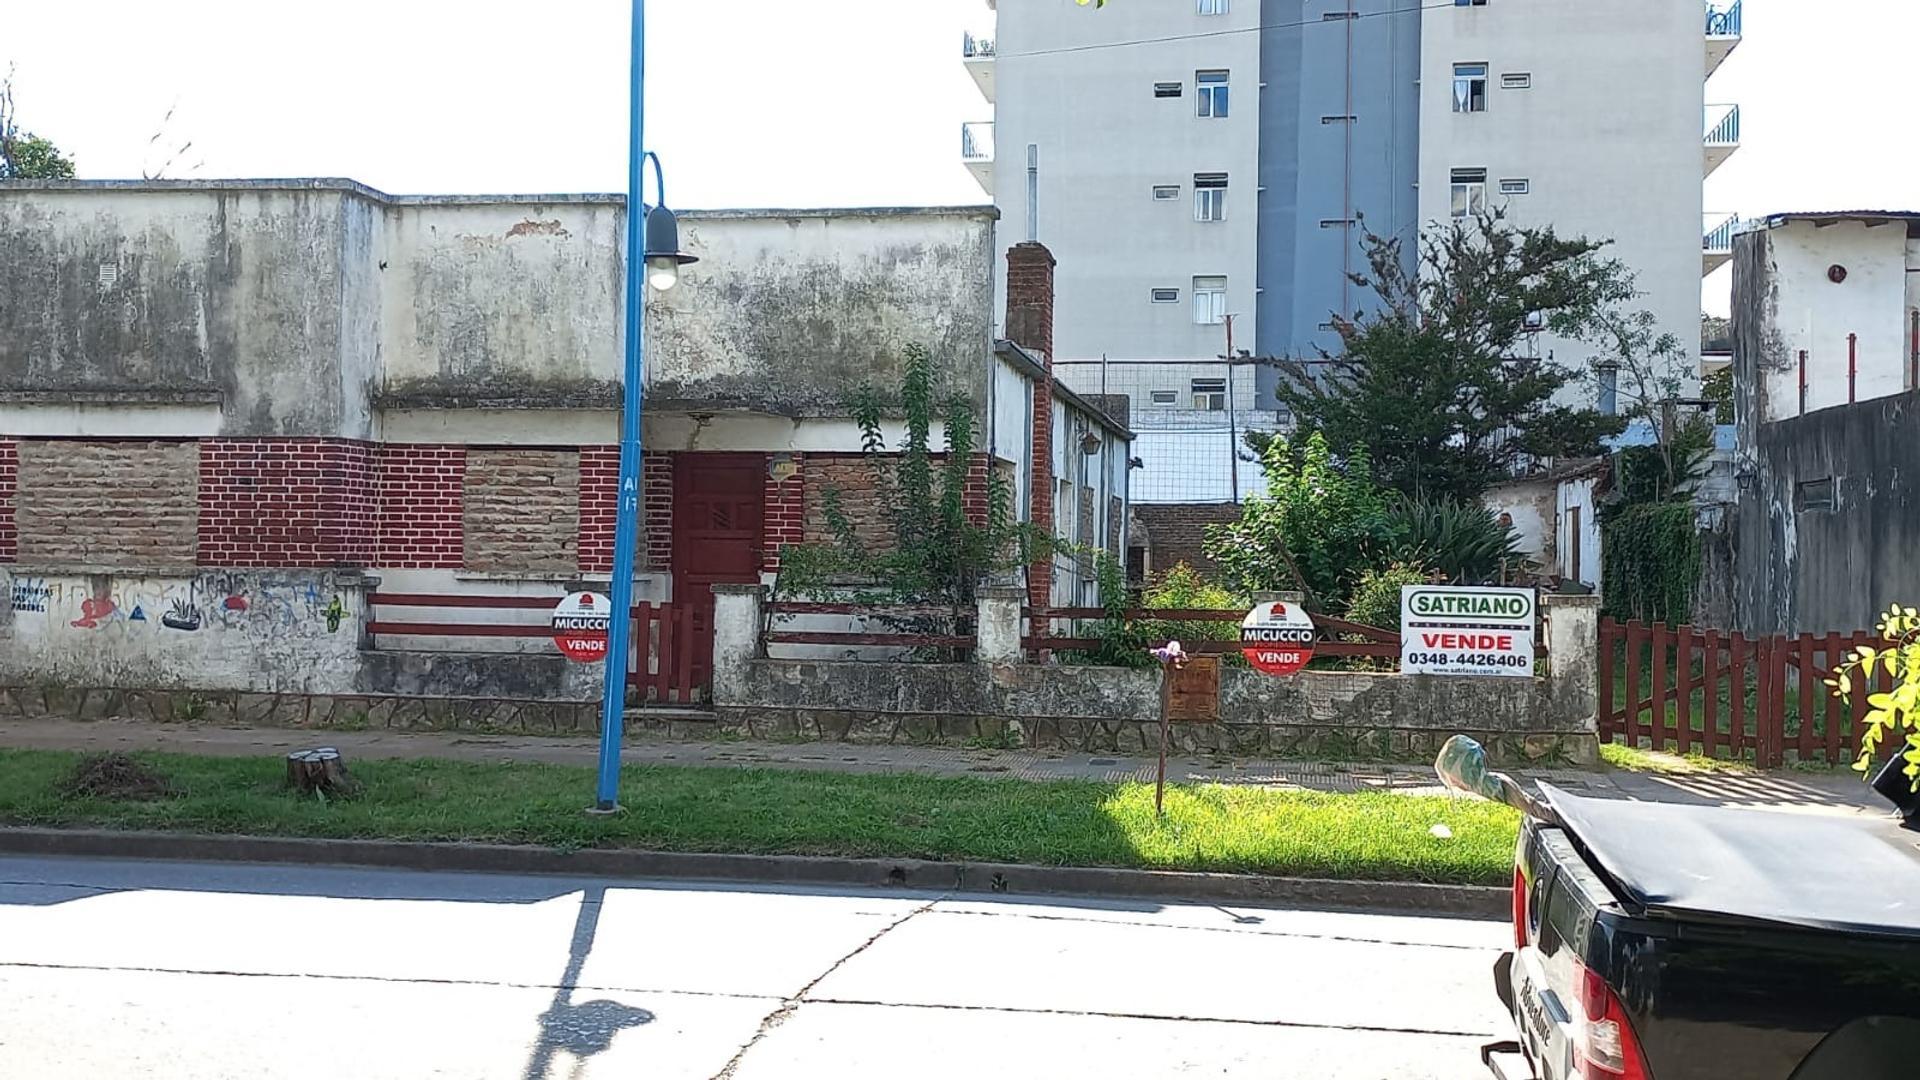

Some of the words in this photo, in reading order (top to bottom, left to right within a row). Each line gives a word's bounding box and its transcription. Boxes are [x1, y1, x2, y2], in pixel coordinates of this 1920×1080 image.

[1417, 596, 1523, 614] SATRIANO
[1244, 630, 1312, 642] MICUCCIO
[1422, 633, 1512, 650] VENDE
[566, 639, 605, 651] VENDE
[1256, 652, 1300, 663] VENDE
[1409, 652, 1527, 667] 0348-4426406
